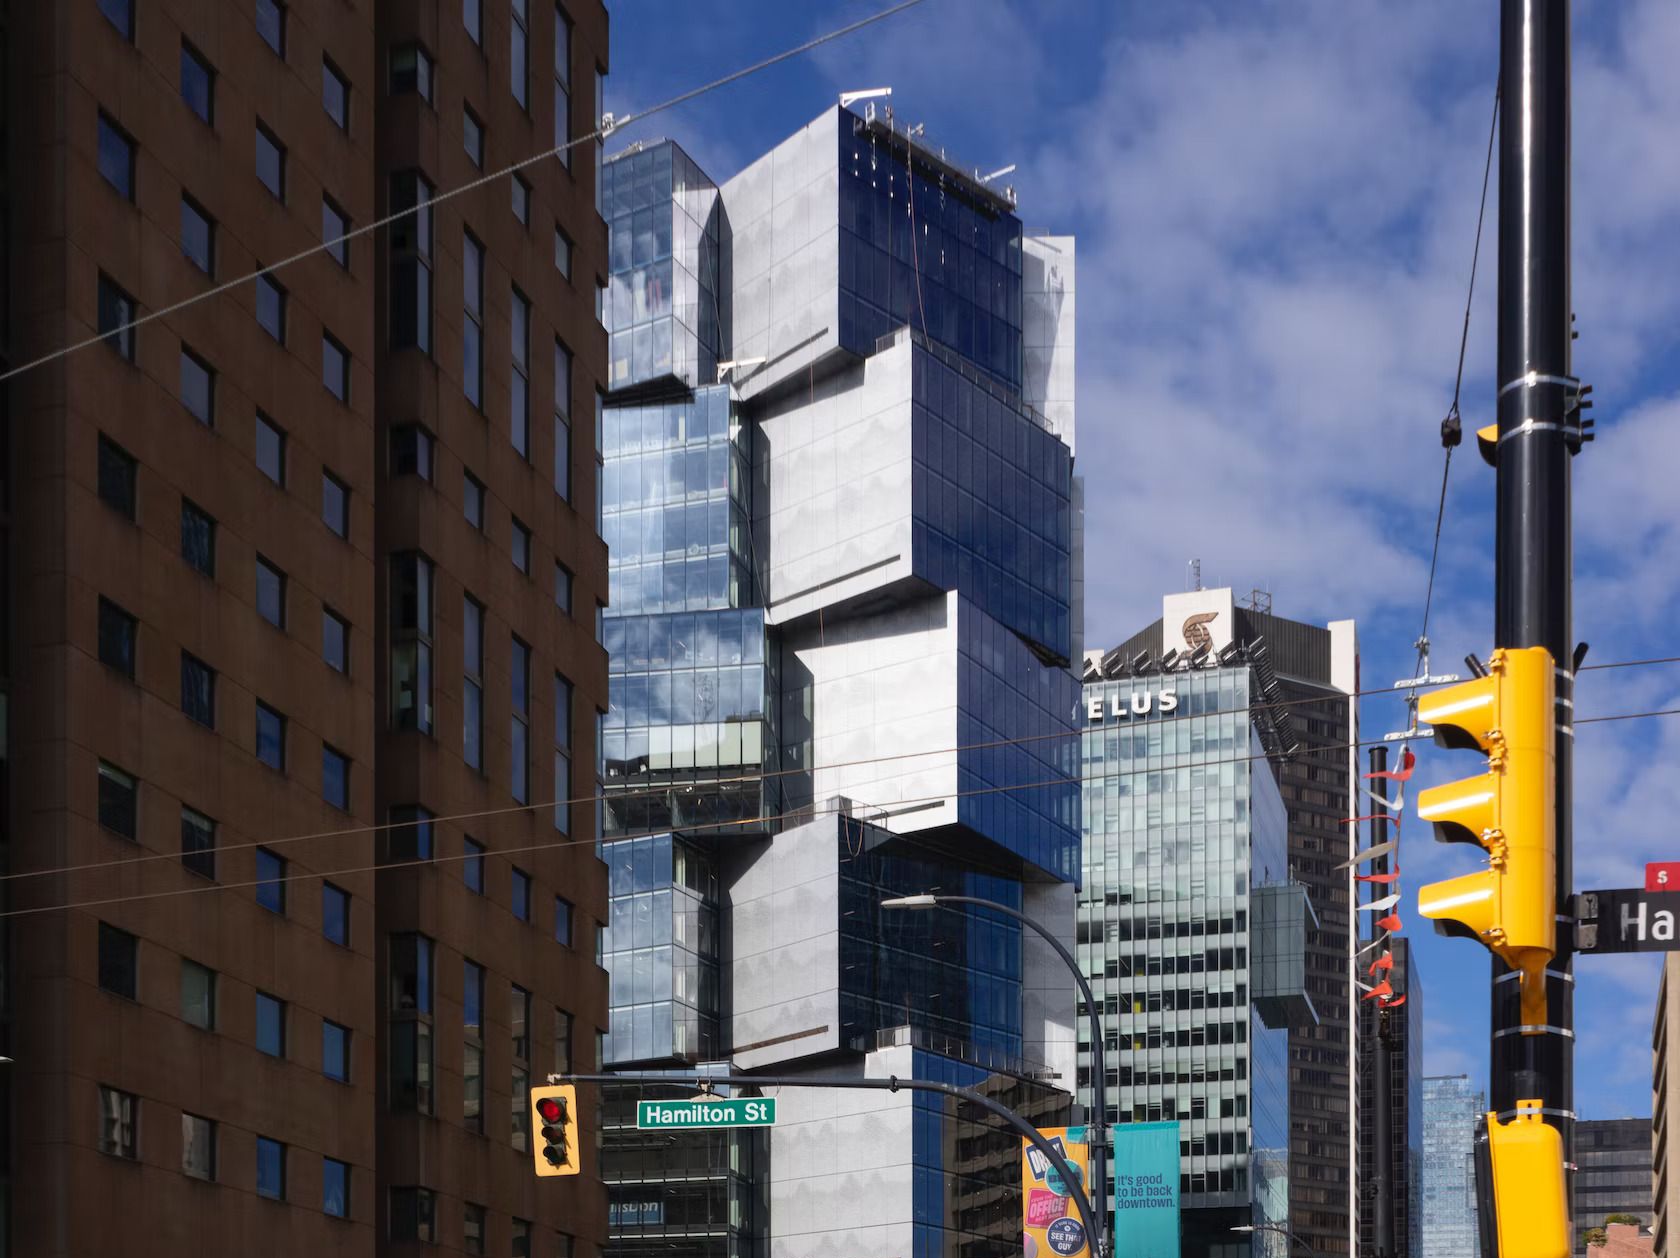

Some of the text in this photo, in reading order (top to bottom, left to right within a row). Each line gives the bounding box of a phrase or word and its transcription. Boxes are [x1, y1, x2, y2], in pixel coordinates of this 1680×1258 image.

[1087, 687, 1178, 719] ELUS
[1621, 902, 1680, 941] Ha
[646, 1102, 768, 1124] Hamilton St
[1117, 1173, 1163, 1187] It's good
[1117, 1184, 1173, 1197] to be back
[1029, 1197, 1065, 1218] OFFICE
[1117, 1198, 1176, 1209] downtown.
[1050, 1232, 1064, 1241] SEE
